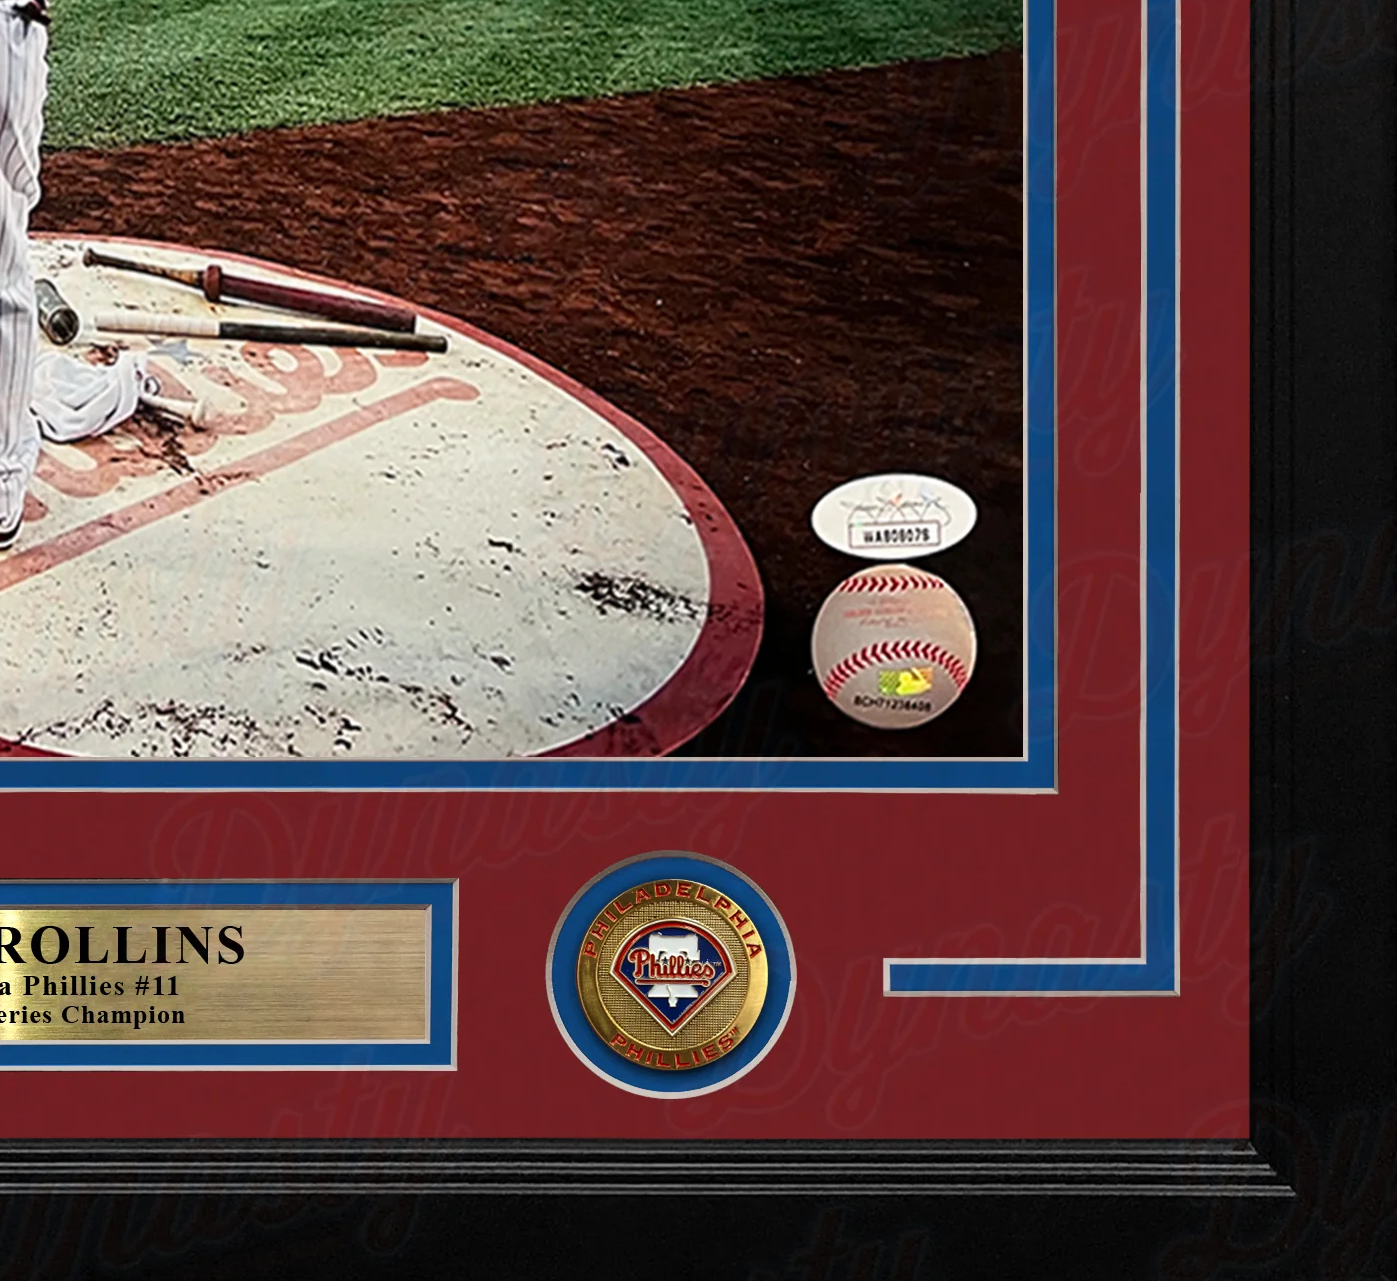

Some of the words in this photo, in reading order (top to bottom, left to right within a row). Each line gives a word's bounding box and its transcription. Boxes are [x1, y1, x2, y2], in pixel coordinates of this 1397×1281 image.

[584, 882, 761, 959] PHILADELPHIA
[628, 947, 715, 980] Phillies
[23, 975, 125, 996] Phillies
[135, 975, 180, 996] #11
[61, 1005, 186, 1029] Champion
